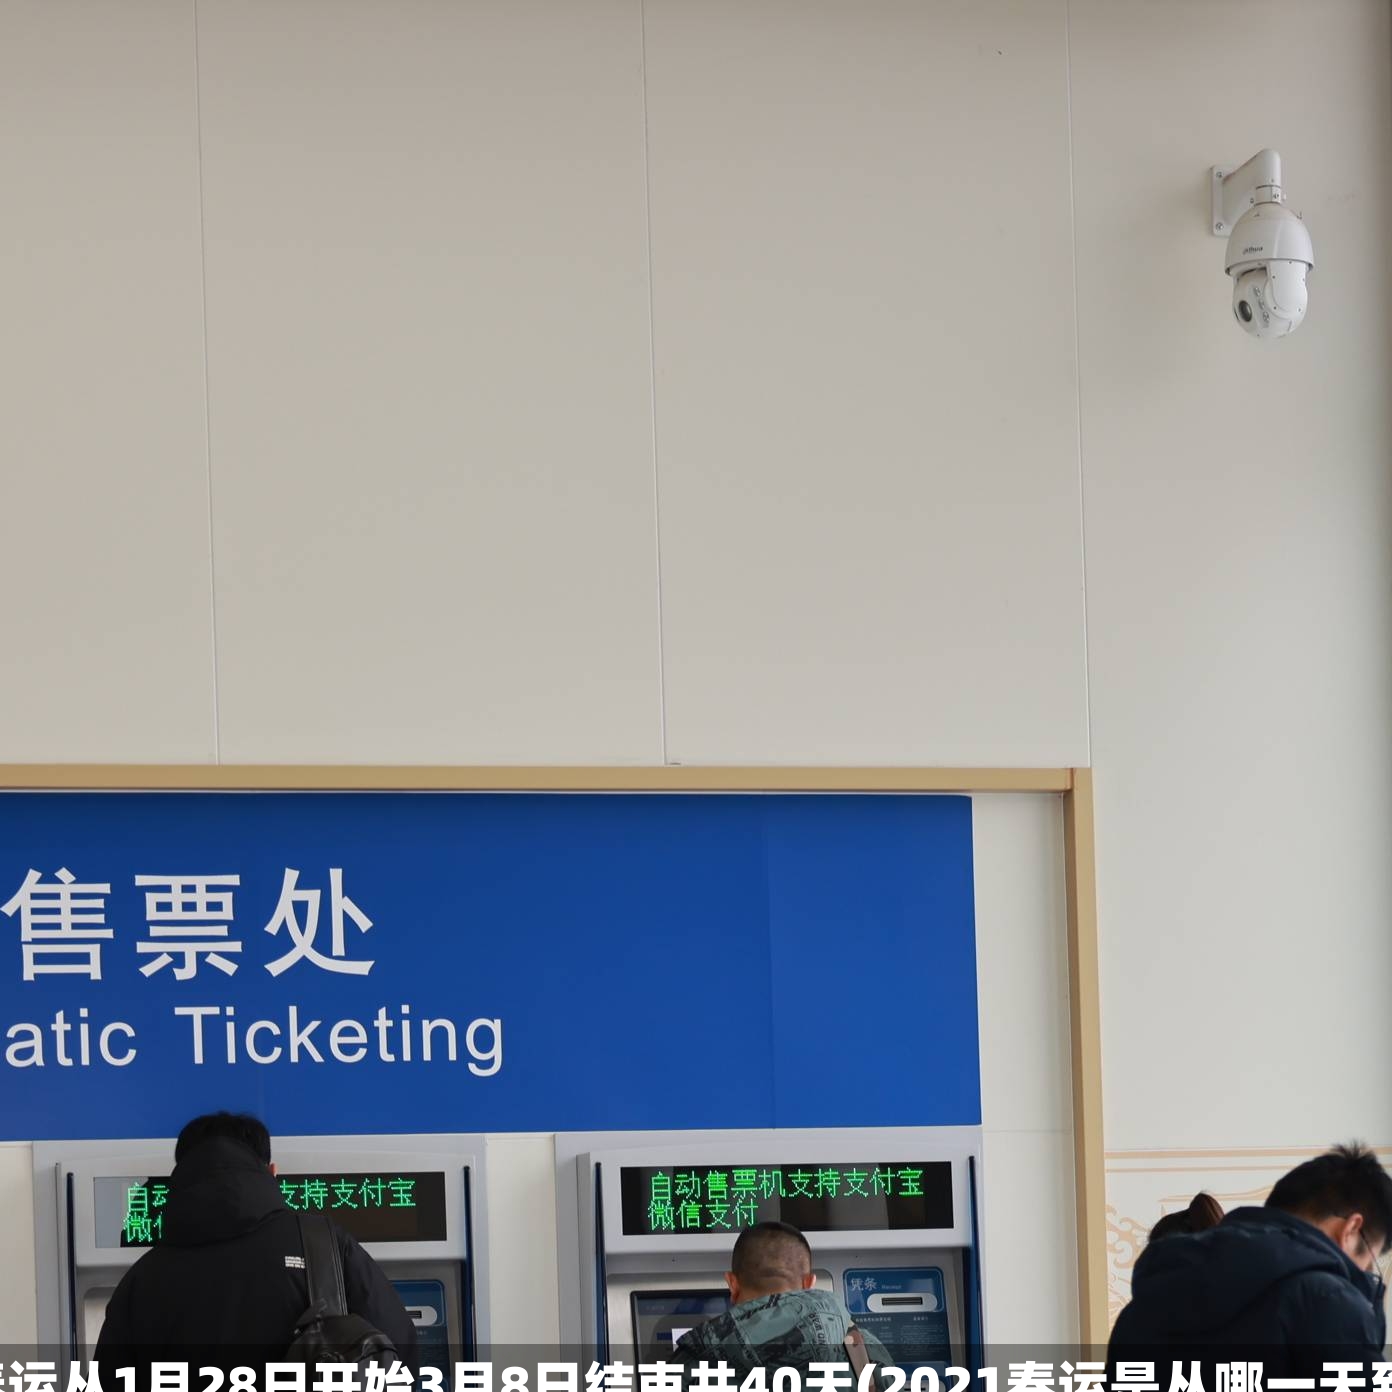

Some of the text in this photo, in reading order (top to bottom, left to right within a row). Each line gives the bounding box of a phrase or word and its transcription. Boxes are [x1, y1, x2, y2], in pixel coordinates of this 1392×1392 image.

[174, 1004, 502, 1077] Ticketing
[650, 1166, 925, 1202] 自动售票机支持支付宝
[648, 1199, 759, 1231] 微信支付
[850, 1278, 878, 1292] 凭条
